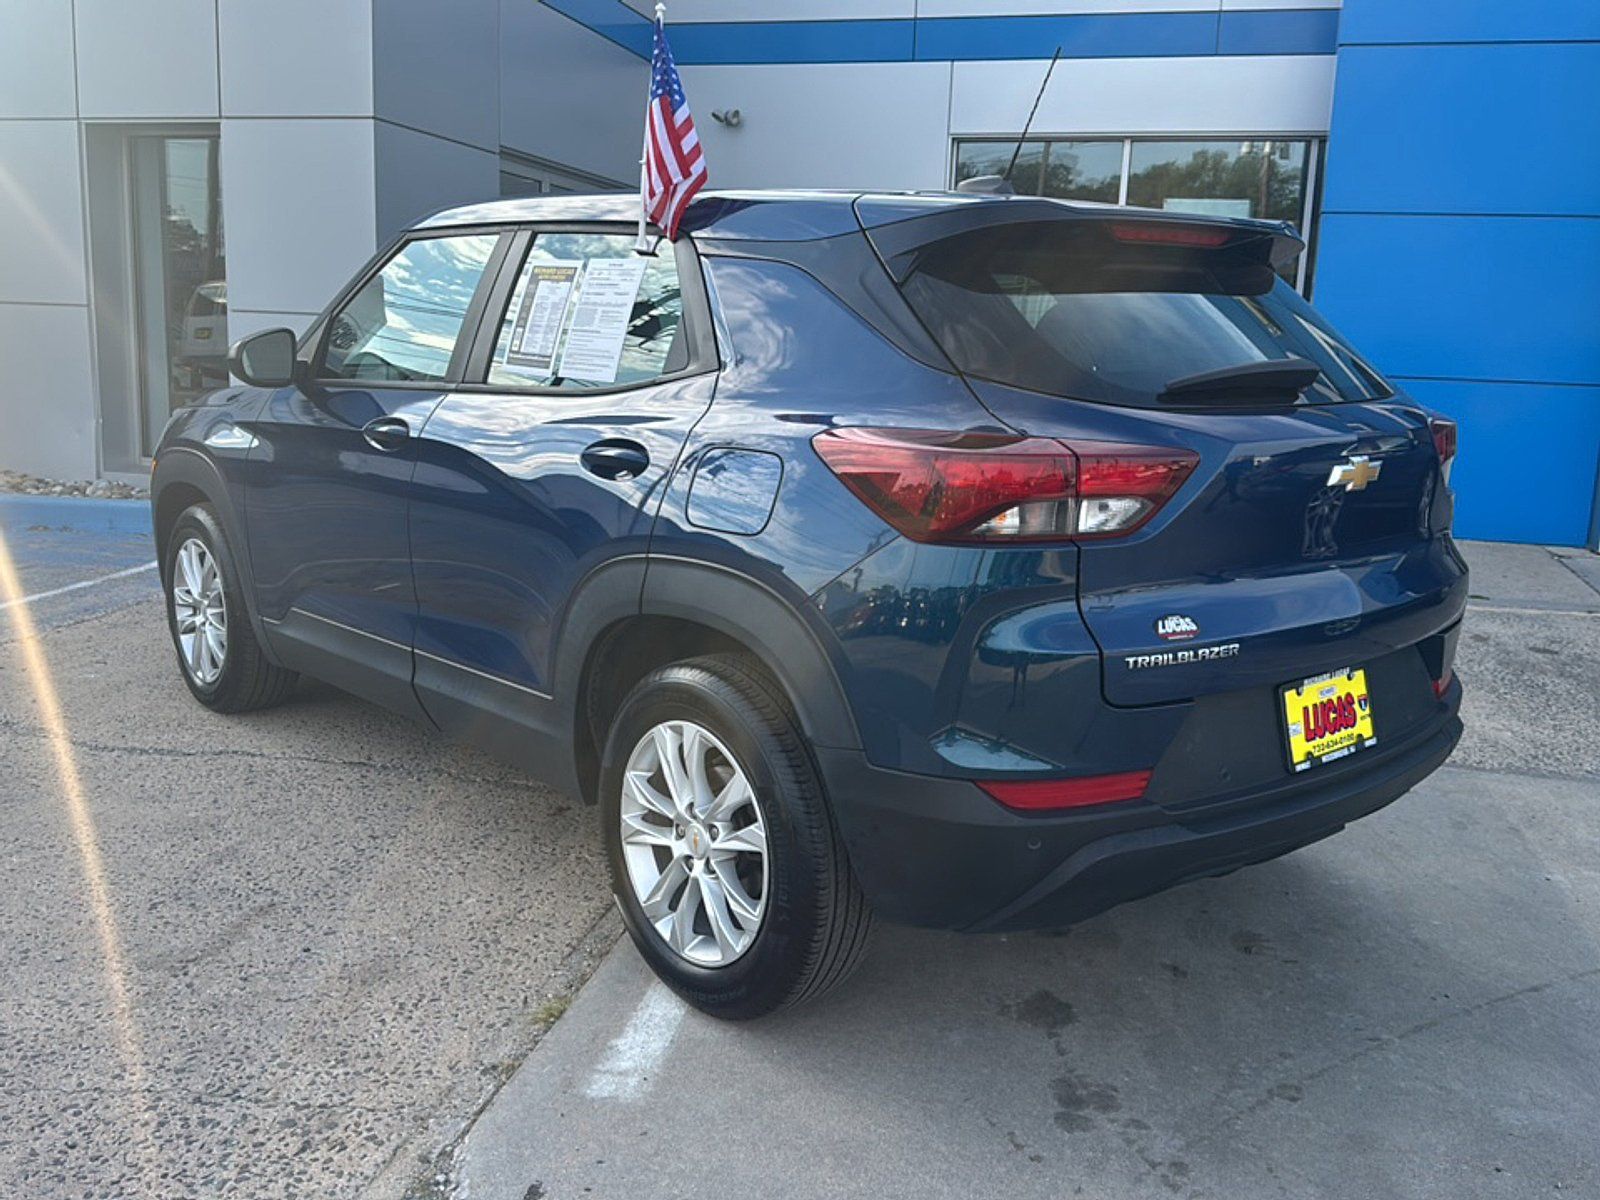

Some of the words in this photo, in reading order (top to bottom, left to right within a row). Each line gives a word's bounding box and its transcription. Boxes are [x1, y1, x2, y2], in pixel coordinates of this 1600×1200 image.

[1158, 616, 1198, 635] LUCAS
[1125, 643, 1240, 670] TRAILBLAZER
[1303, 693, 1356, 742] LUCAS
